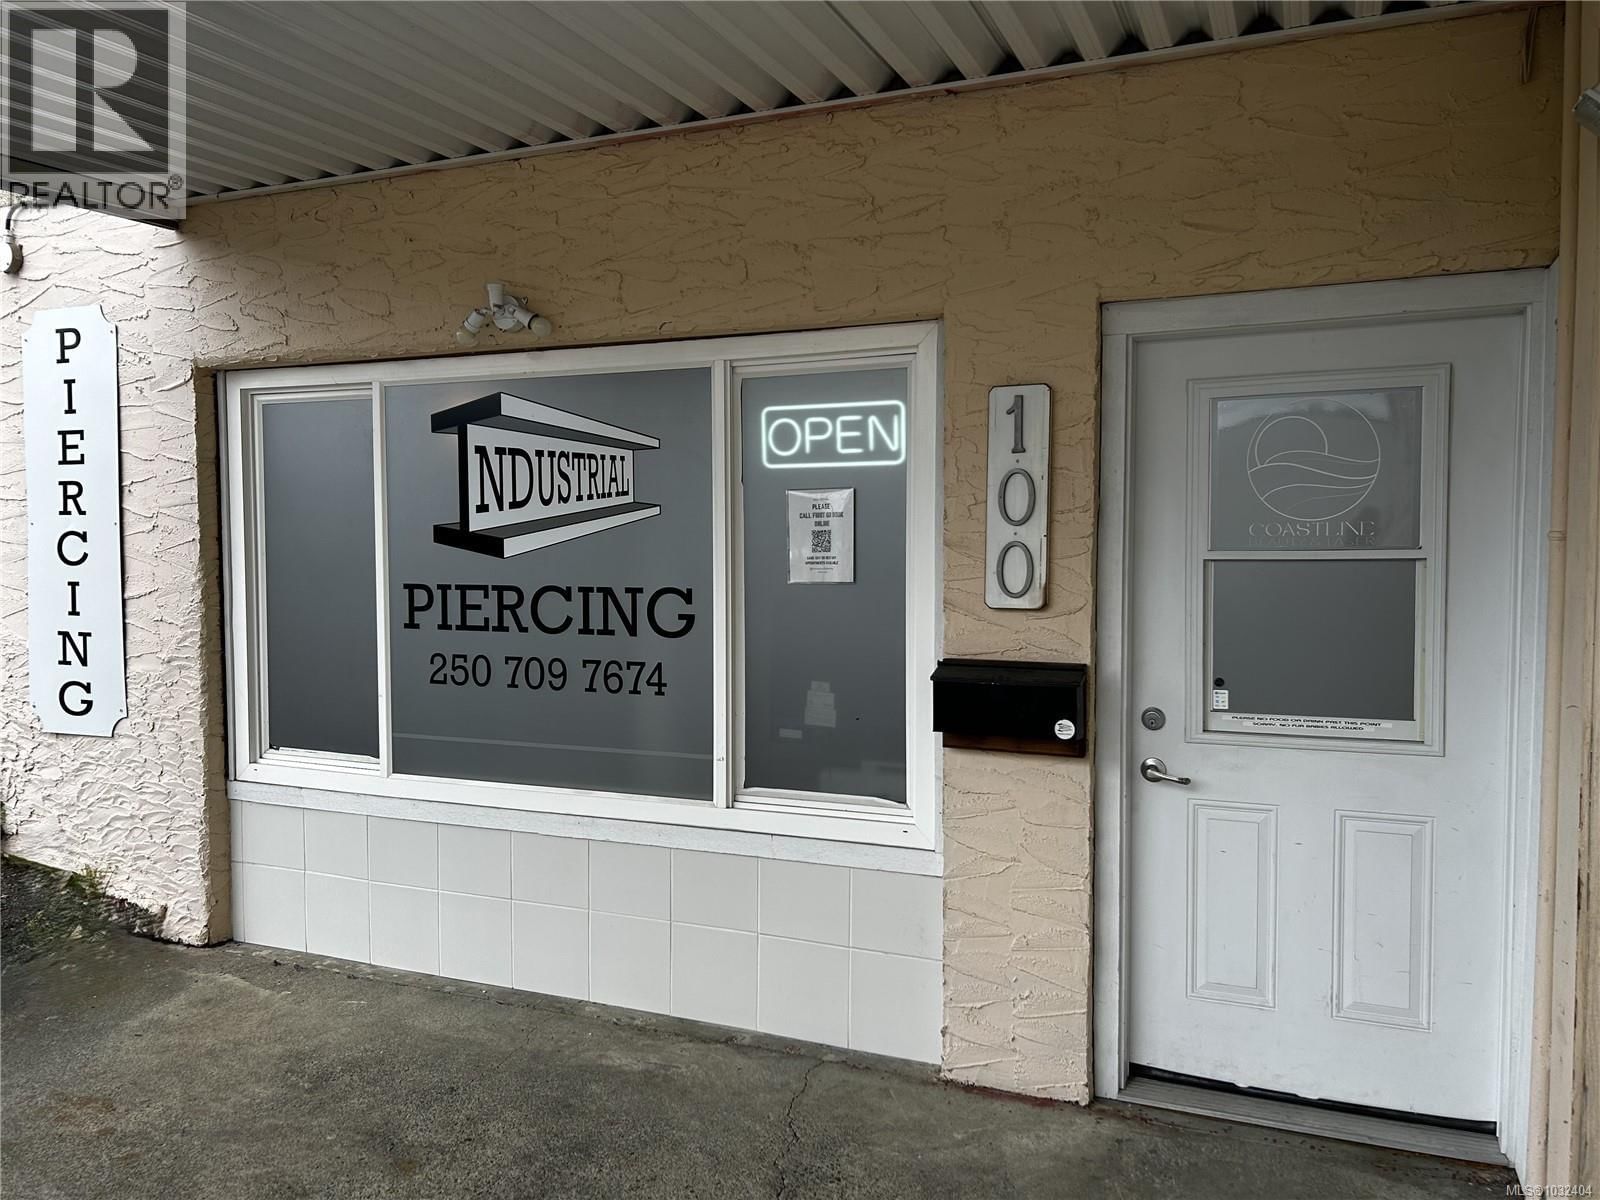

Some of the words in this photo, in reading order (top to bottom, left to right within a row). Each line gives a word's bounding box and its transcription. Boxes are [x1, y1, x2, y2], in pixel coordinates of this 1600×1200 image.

[767, 413, 900, 457] OPEN
[55, 327, 94, 717] PIERCING
[1248, 520, 1376, 537] COASTLINE
[402, 583, 696, 639] PIERCING
[429, 652, 492, 687] 250
[504, 656, 568, 691] 709
[582, 659, 668, 697] 7674
